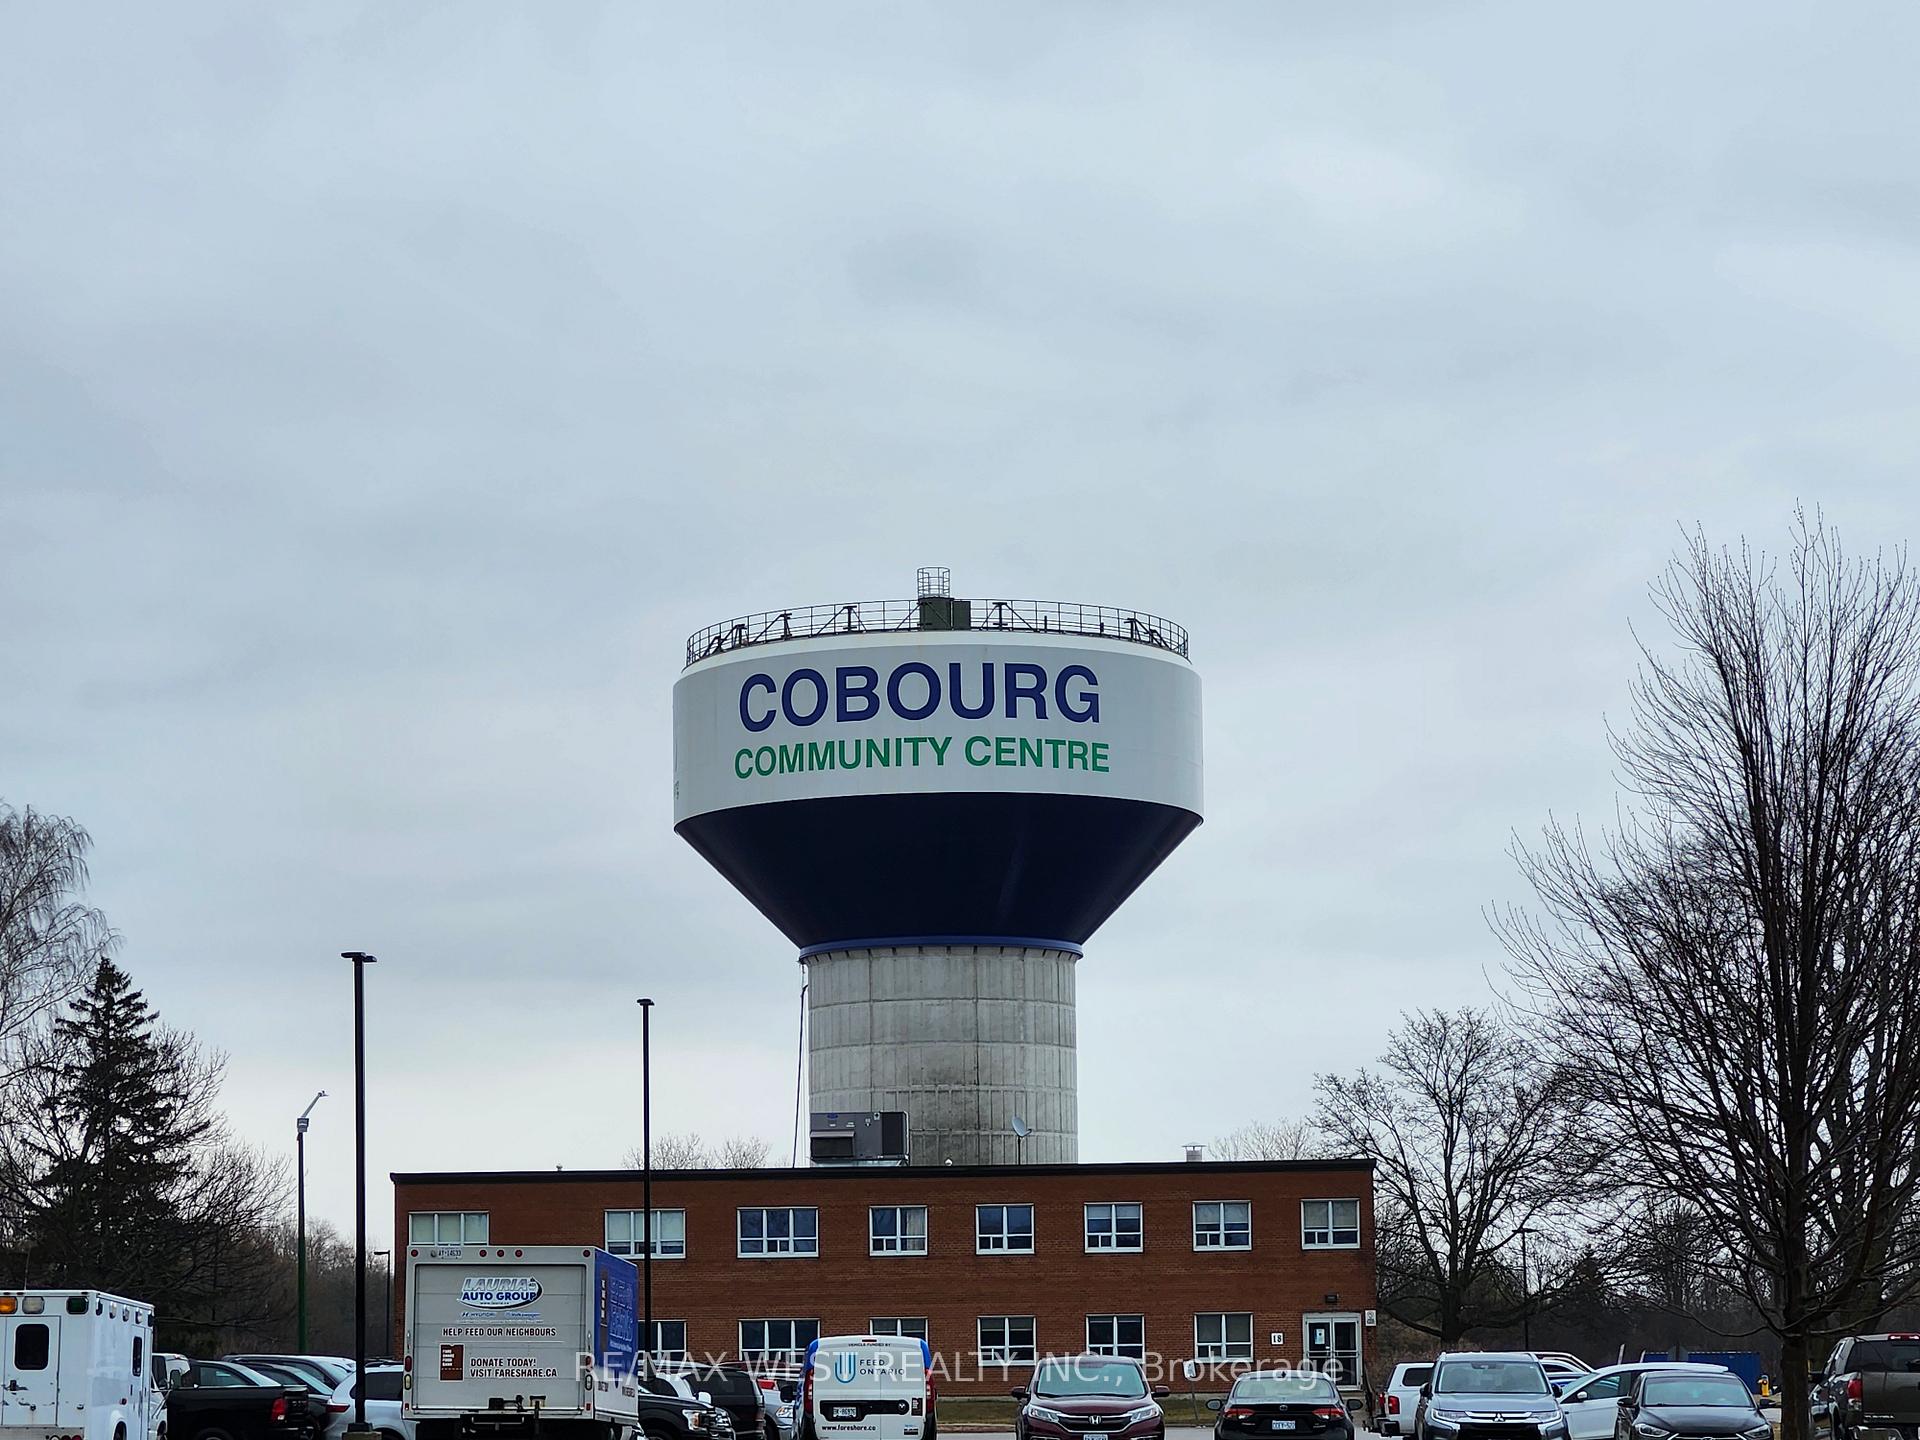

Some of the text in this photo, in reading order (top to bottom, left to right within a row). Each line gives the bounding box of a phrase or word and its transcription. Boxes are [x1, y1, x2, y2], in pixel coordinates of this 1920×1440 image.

[739, 661, 1100, 732] COBOURG
[735, 735, 1110, 779] COMMUNITY CENTRE
[463, 1278, 528, 1292] LAURIA
[462, 1291, 537, 1301] AUTO GROUP
[443, 1328, 556, 1337] HELP FEED OUR NEIGHBOURS
[1273, 1335, 1282, 1343] 18
[471, 1358, 536, 1367] DONATE TODAY!
[470, 1369, 557, 1378] VISIT FARESHARE.CA
